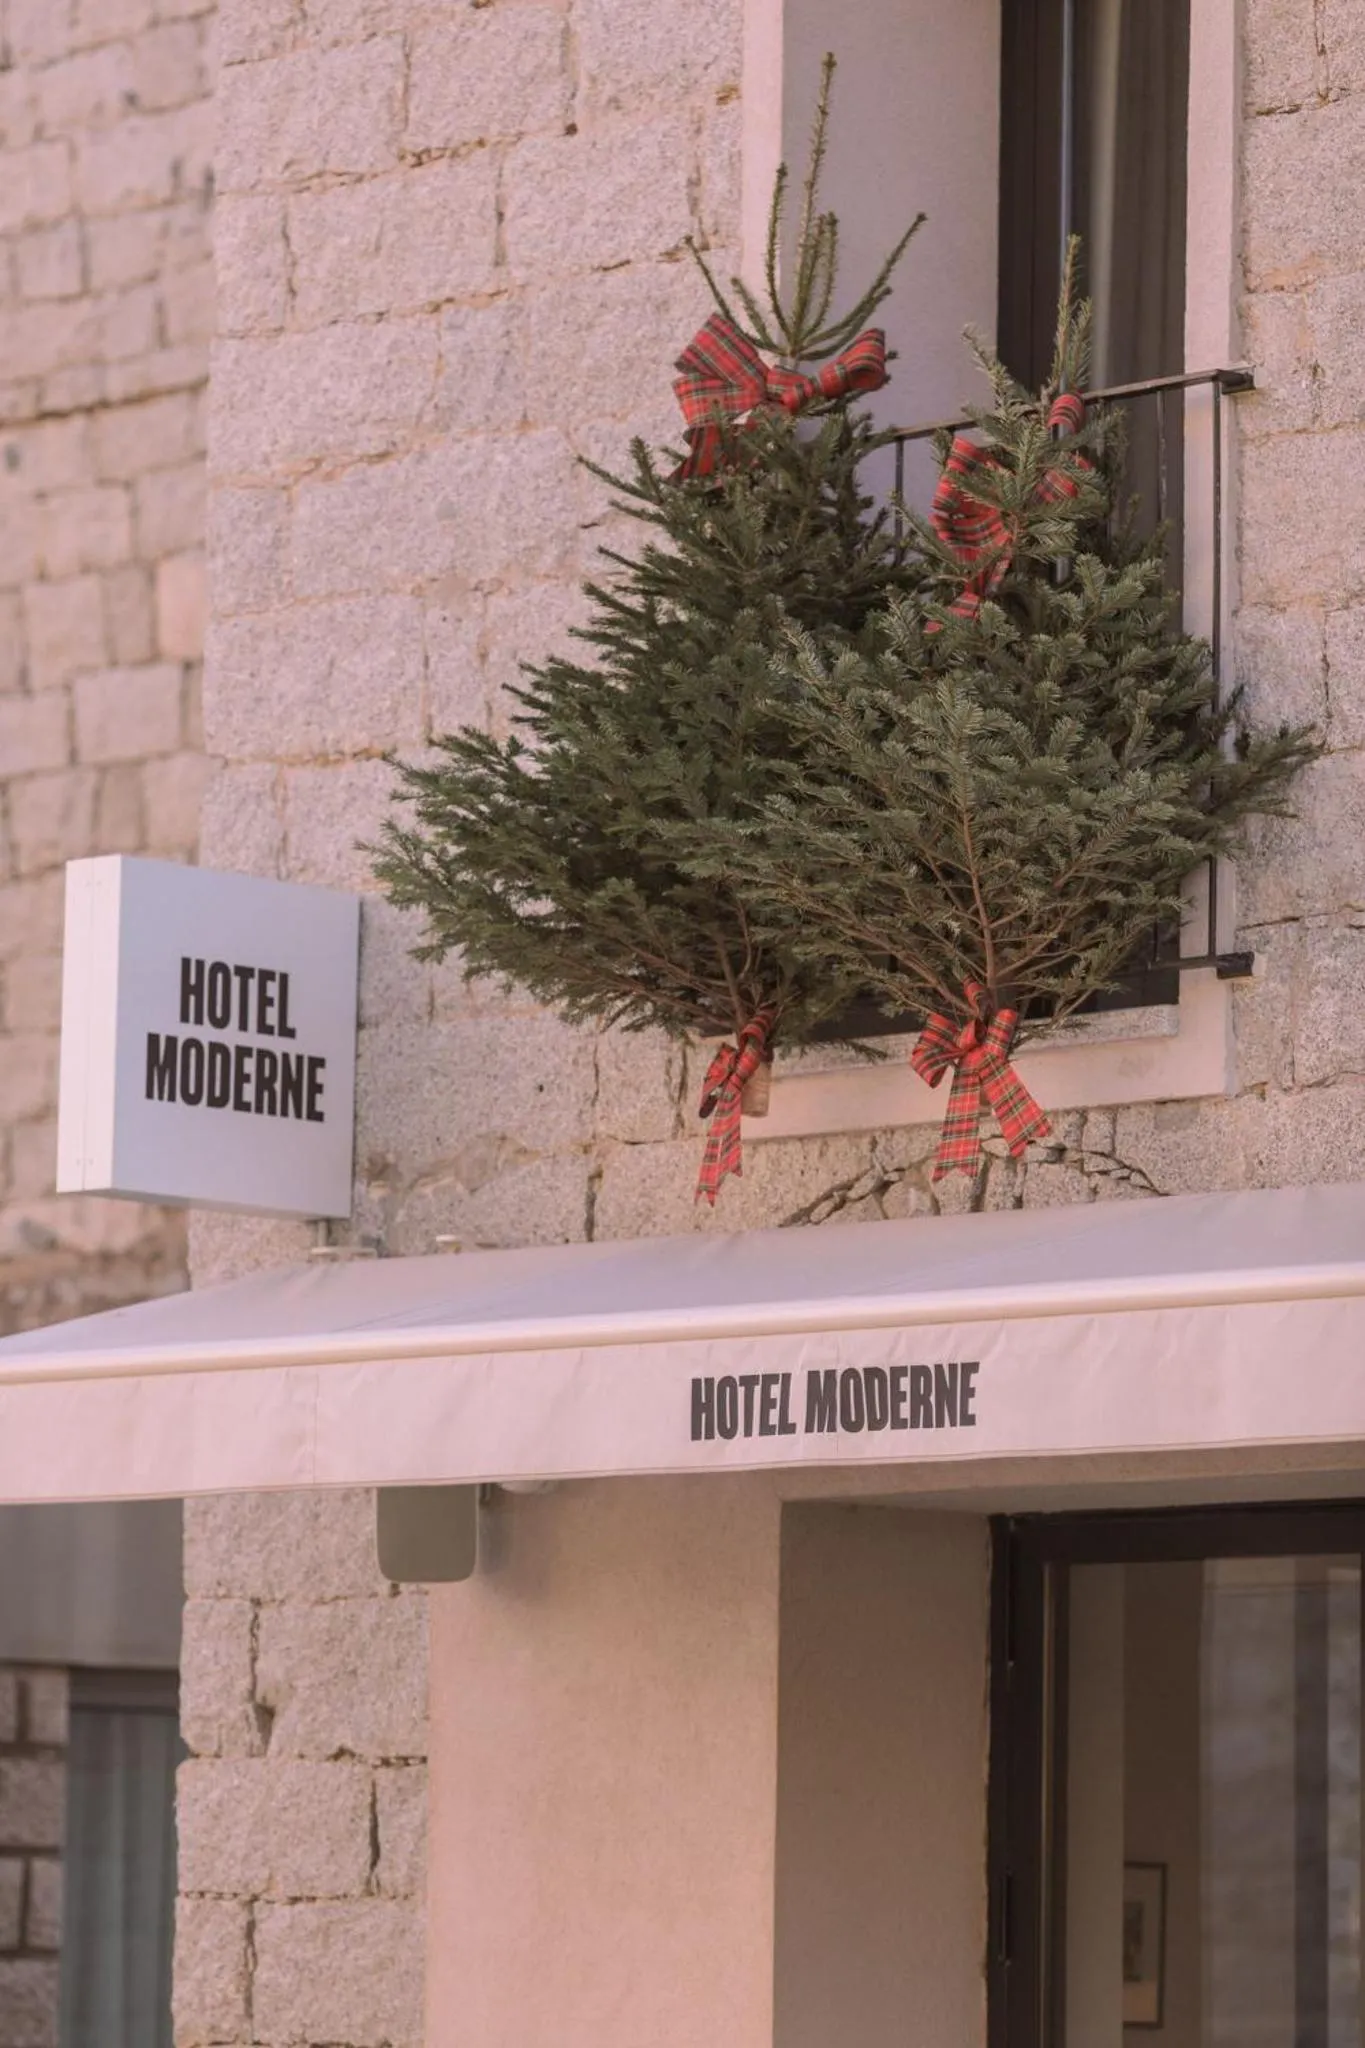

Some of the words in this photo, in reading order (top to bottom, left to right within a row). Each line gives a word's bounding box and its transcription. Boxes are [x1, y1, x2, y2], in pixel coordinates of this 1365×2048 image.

[179, 956, 297, 1040] HOTEL
[145, 1032, 327, 1123] MODERNE
[691, 1372, 797, 1441] HOTEL
[804, 1361, 980, 1434] MODERNE
